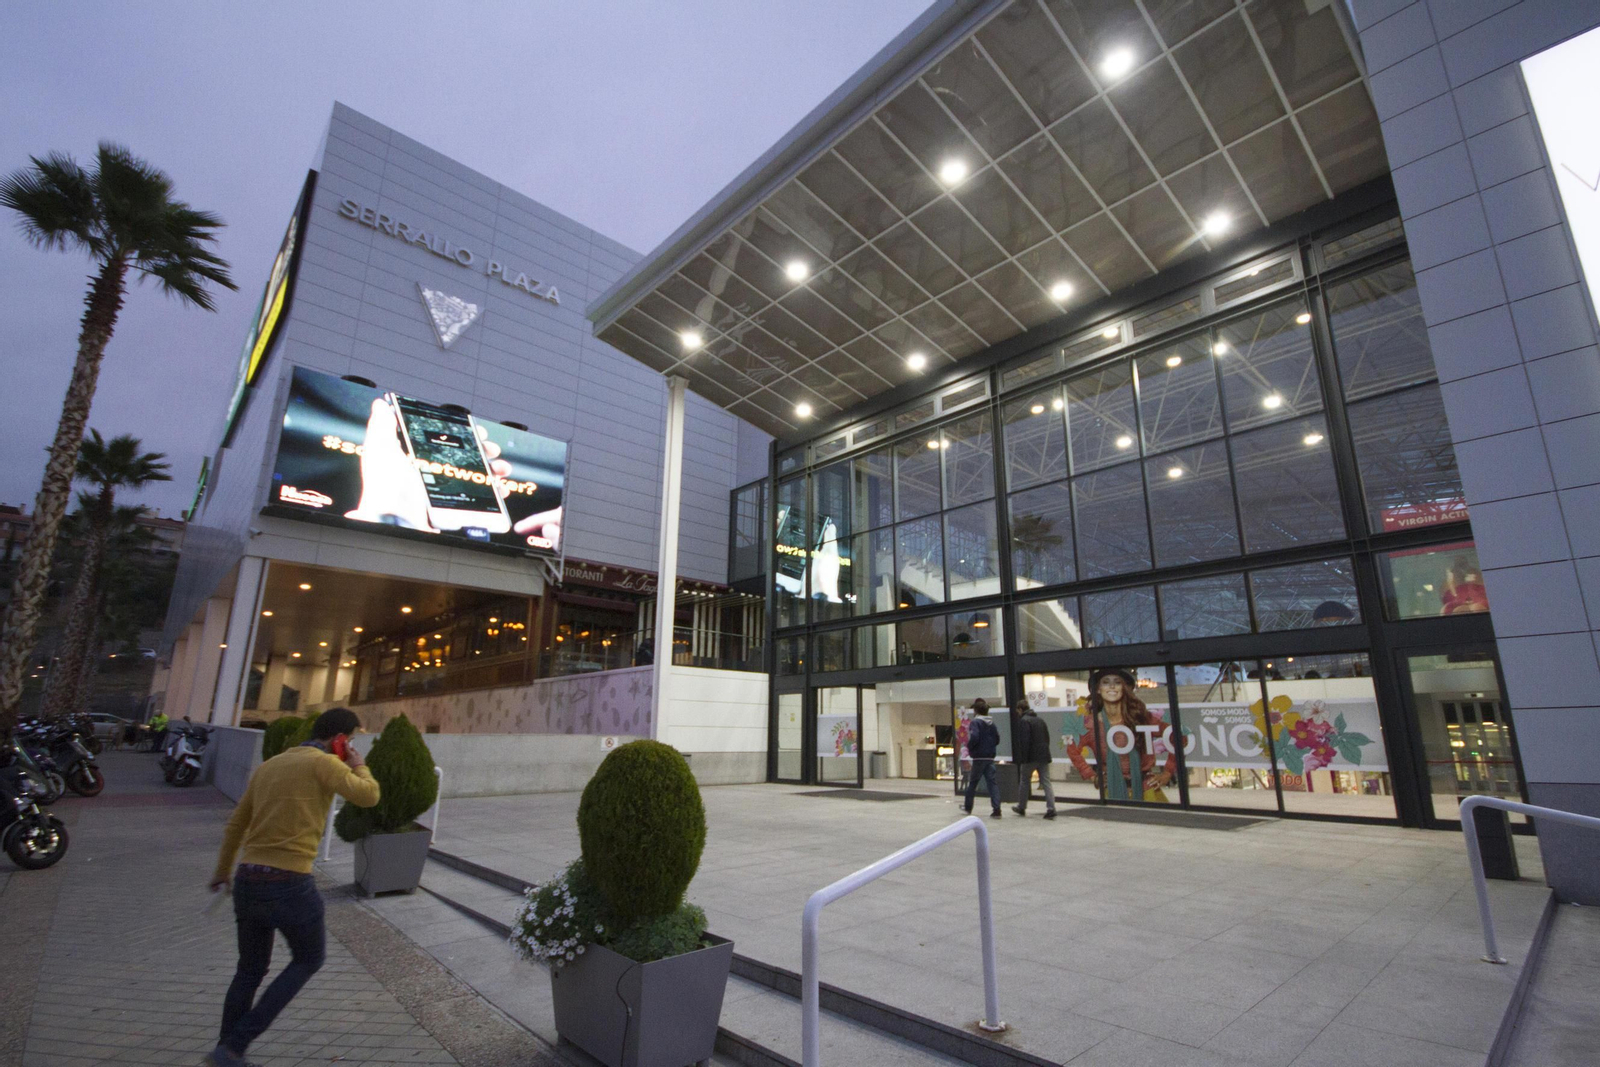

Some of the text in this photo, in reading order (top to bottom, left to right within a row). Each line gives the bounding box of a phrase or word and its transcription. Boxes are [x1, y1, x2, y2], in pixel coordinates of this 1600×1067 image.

[338, 199, 474, 267] SERRALLO
[484, 257, 561, 305] PLAZA
[1398, 515, 1437, 527] VIRGIN
[614, 574, 633, 589] La
[1201, 708, 1251, 716] SOMOS MODA
[1224, 716, 1252, 724] SOMOS
